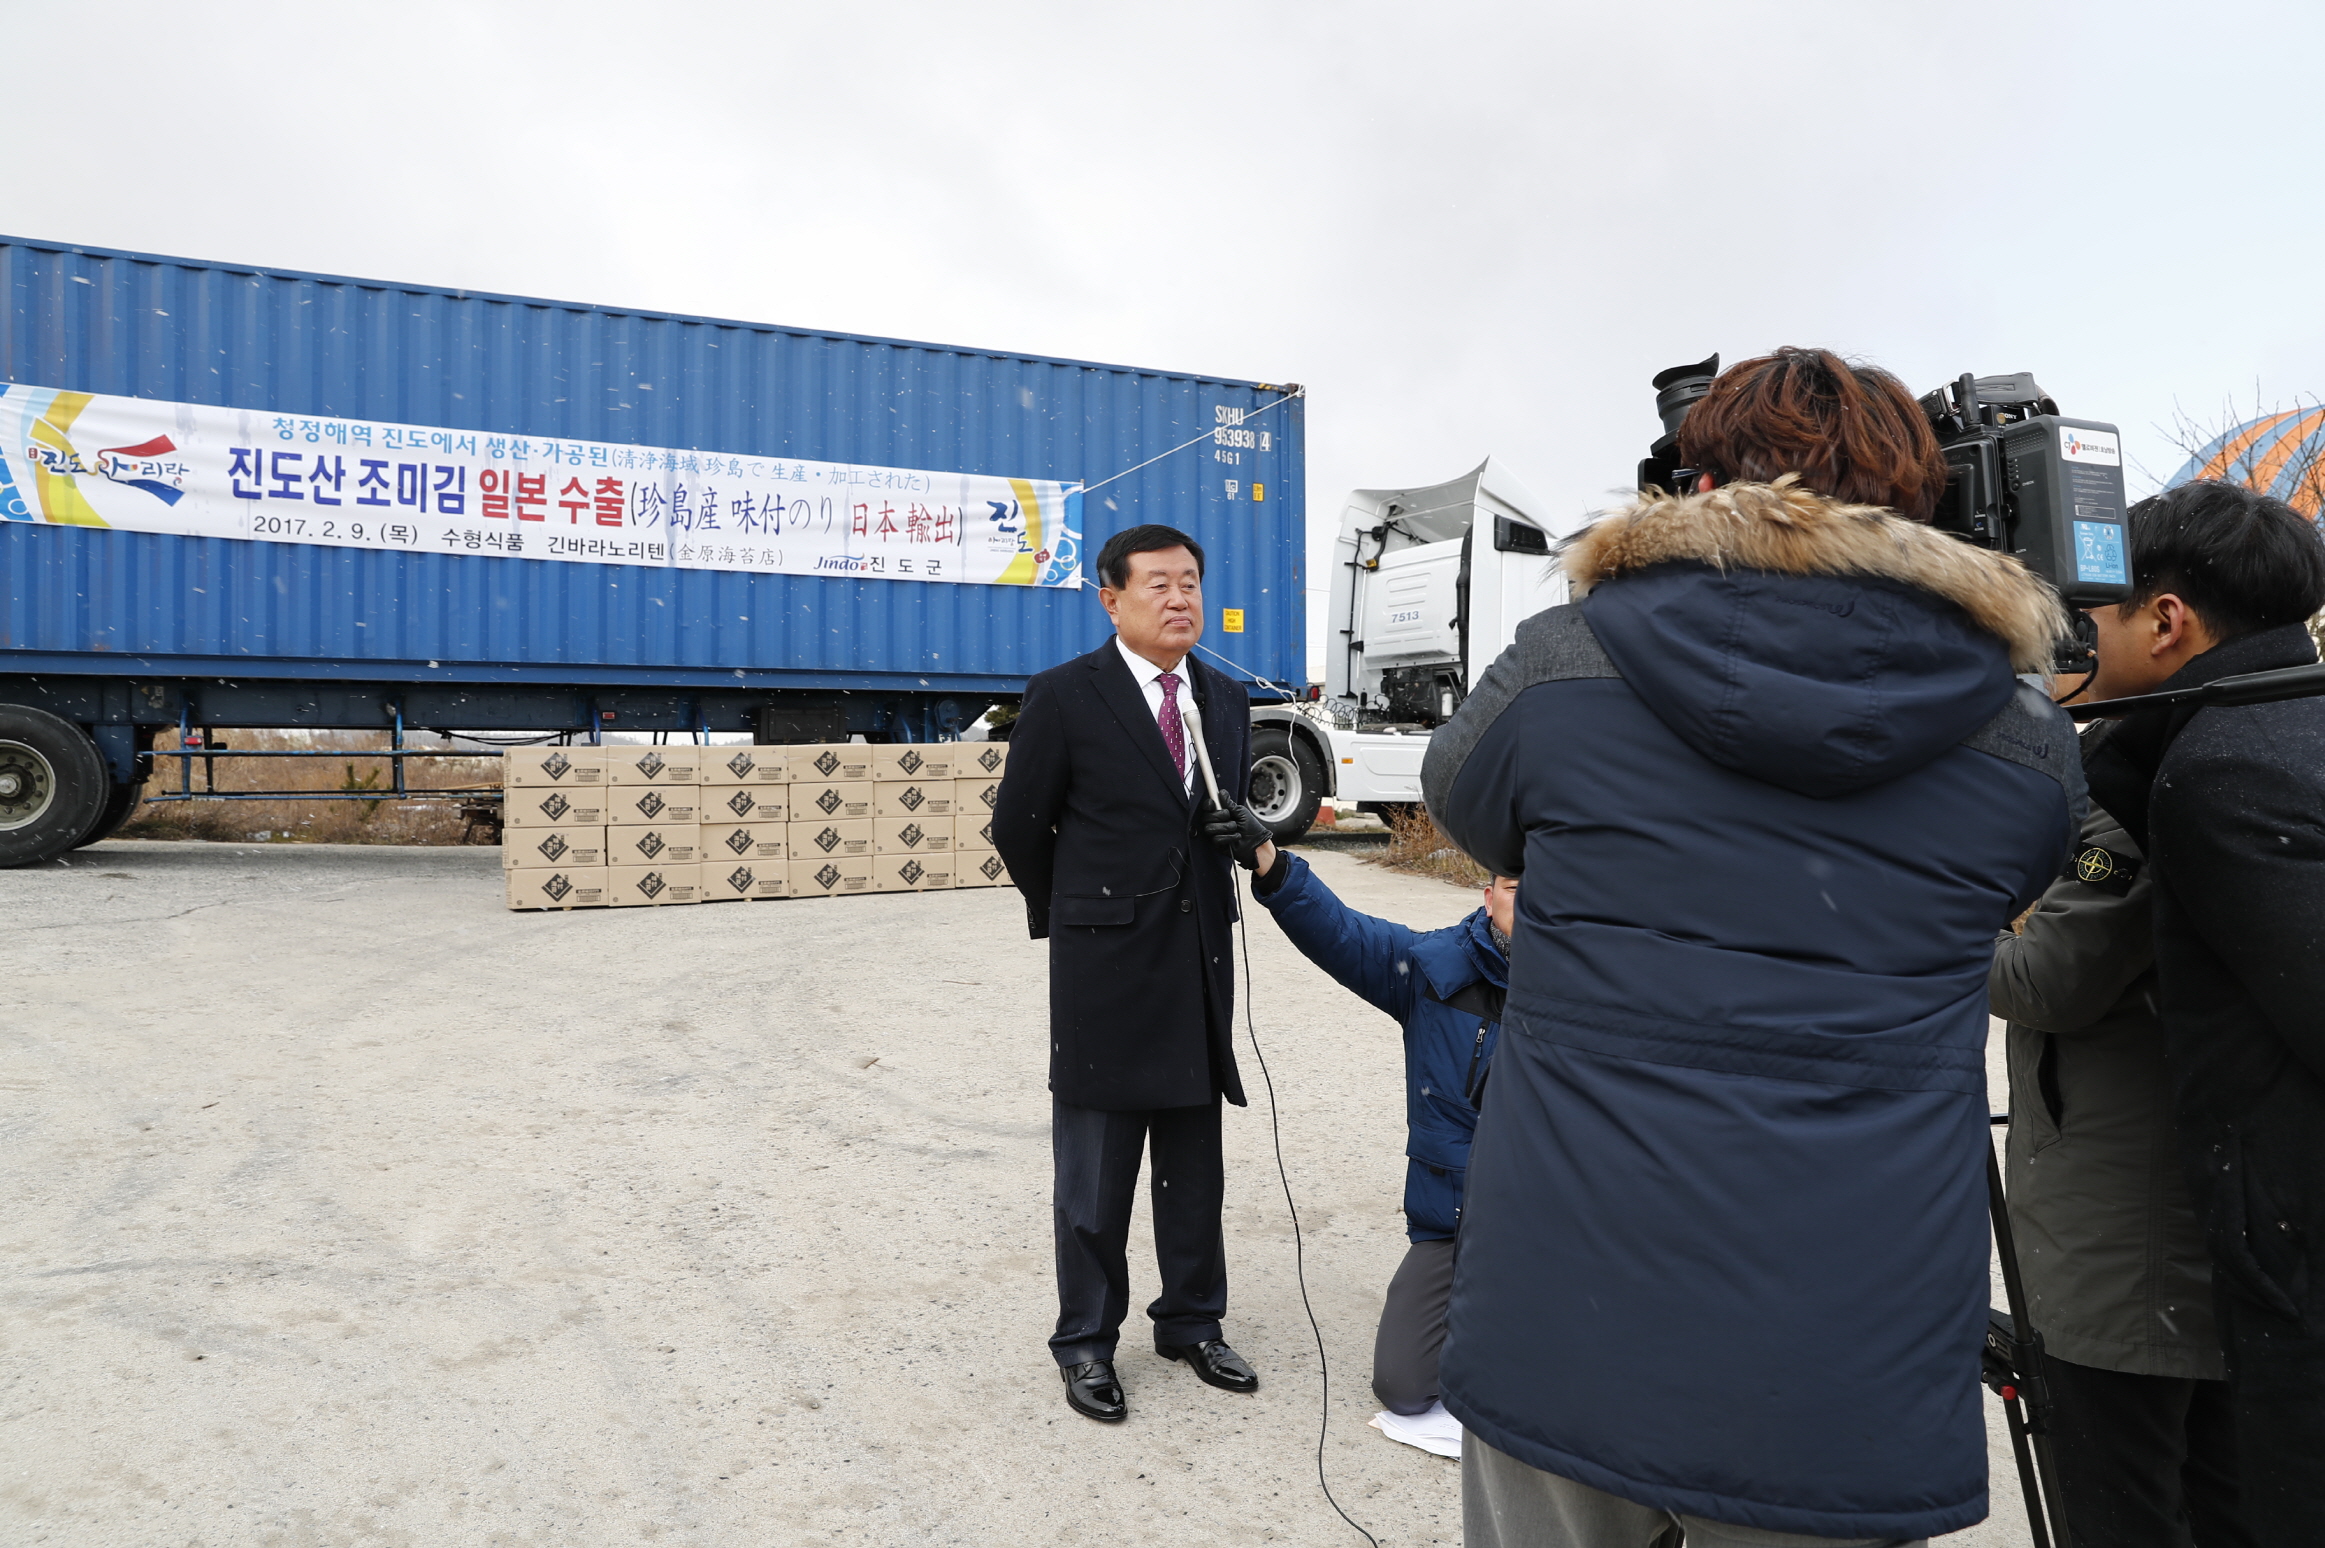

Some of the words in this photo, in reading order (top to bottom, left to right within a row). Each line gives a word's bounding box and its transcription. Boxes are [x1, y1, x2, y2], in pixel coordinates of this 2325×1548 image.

[1215, 405, 1244, 425] SKHU
[272, 417, 372, 447] 청정해역
[382, 427, 476, 456] 진도에서
[1214, 426, 1255, 449] 953938
[40, 450, 88, 473] 진도
[1214, 449, 1240, 465] 45G1
[228, 447, 346, 506] 진도산
[357, 458, 465, 515] 조미김
[479, 468, 547, 522] 일본
[254, 515, 313, 537] 2017.
[322, 521, 341, 539] 2.
[351, 523, 370, 541] 9.
[381, 523, 418, 545] (목)
[441, 528, 524, 552] 수형식품
[813, 555, 859, 571] Jindo
[1391, 610, 1419, 623] 7513
